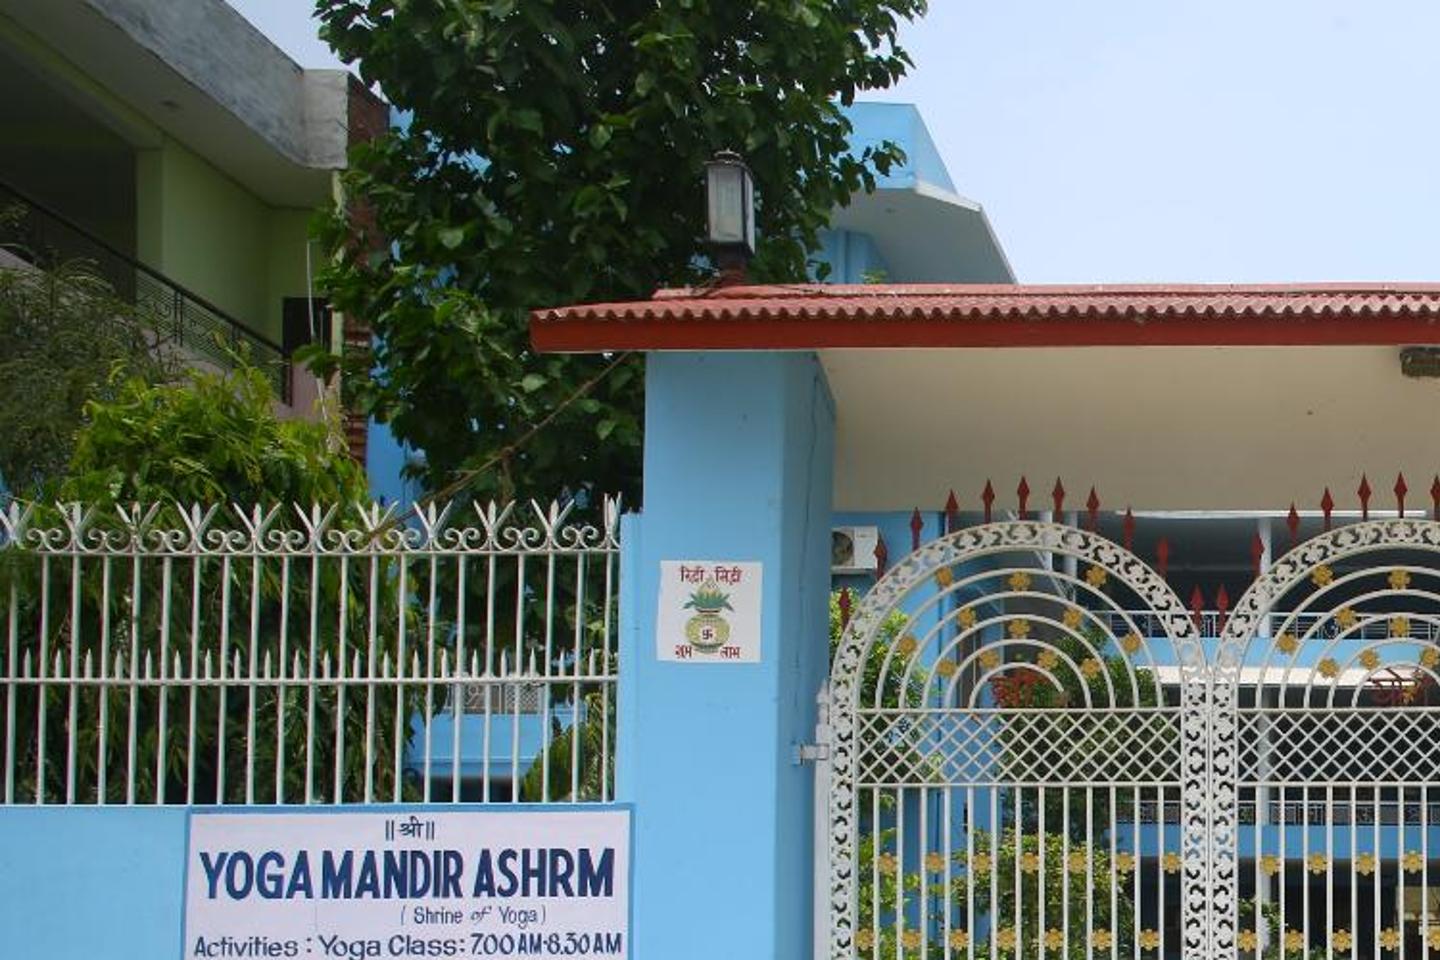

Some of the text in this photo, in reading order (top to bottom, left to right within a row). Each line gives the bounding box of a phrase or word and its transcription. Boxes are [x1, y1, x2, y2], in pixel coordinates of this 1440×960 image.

[200, 848, 615, 900] YOGA MANDIR ASHRM
[470, 906, 492, 924] of
[389, 933, 466, 956] Class:
